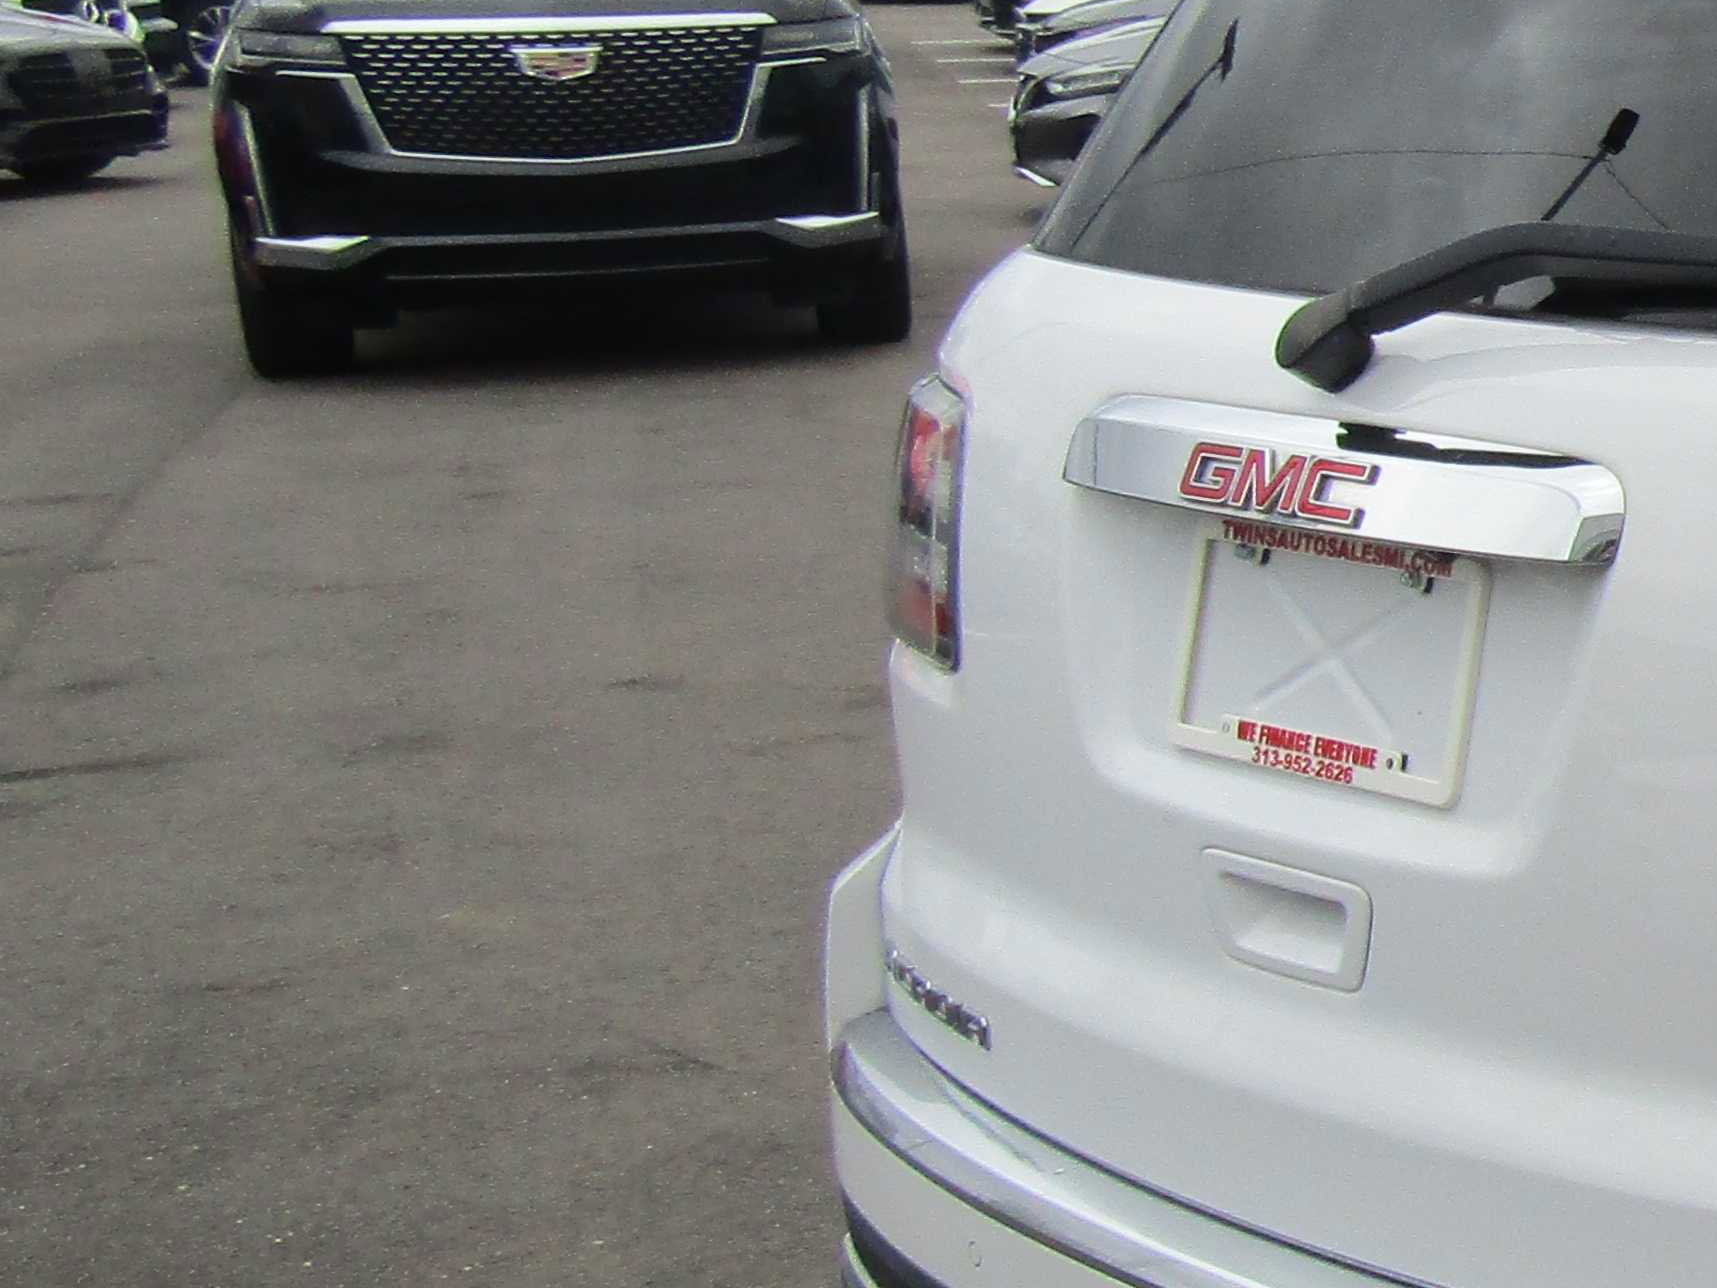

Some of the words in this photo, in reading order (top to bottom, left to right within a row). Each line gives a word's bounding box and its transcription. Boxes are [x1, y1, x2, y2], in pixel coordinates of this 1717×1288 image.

[1179, 441, 1379, 527] GMC
[1221, 519, 1454, 578] TWINSAUTOSALESMI.COM
[1237, 720, 1258, 743] WE
[1259, 724, 1313, 754] FINANCE
[1313, 736, 1378, 770] EVERYONE
[1251, 746, 1353, 784] 313-952-2626
